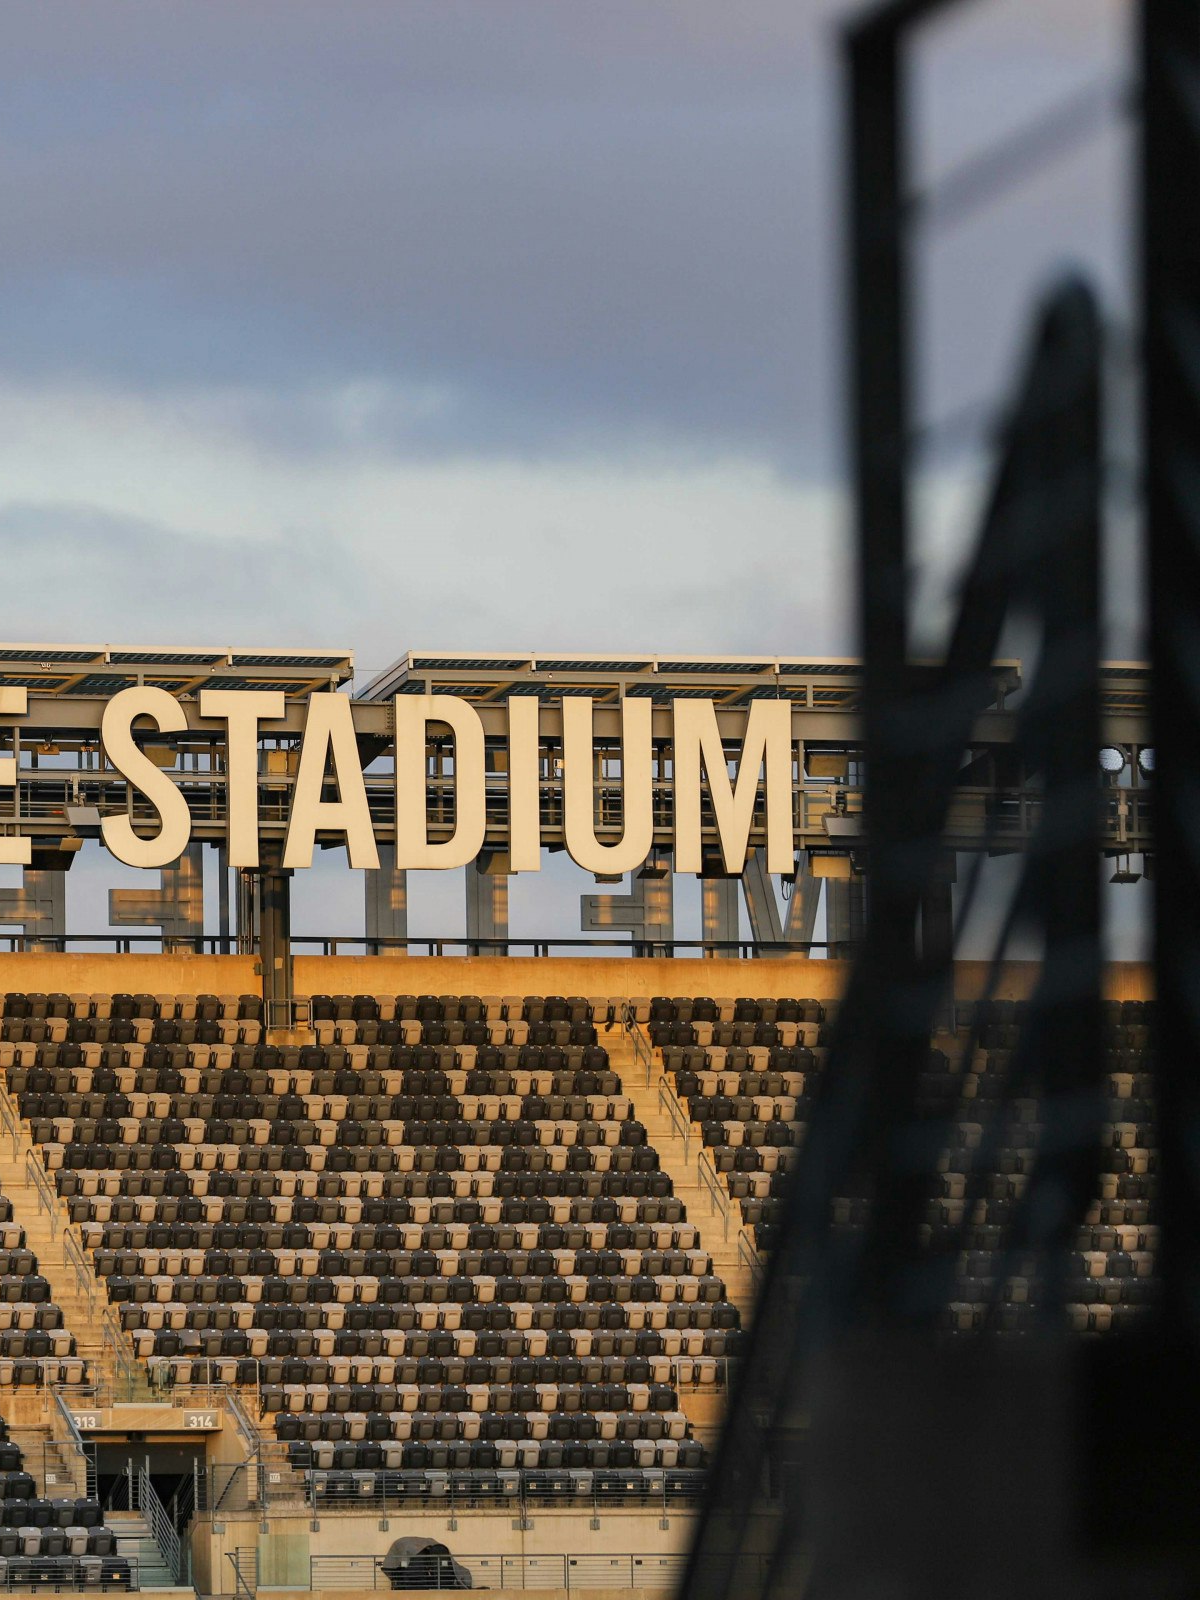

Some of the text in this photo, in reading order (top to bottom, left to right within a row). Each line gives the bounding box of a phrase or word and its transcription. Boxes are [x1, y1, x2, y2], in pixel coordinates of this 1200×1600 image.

[101, 686, 794, 875] STADIUM
[73, 1416, 96, 1428] 313
[189, 1415, 213, 1428] 314
